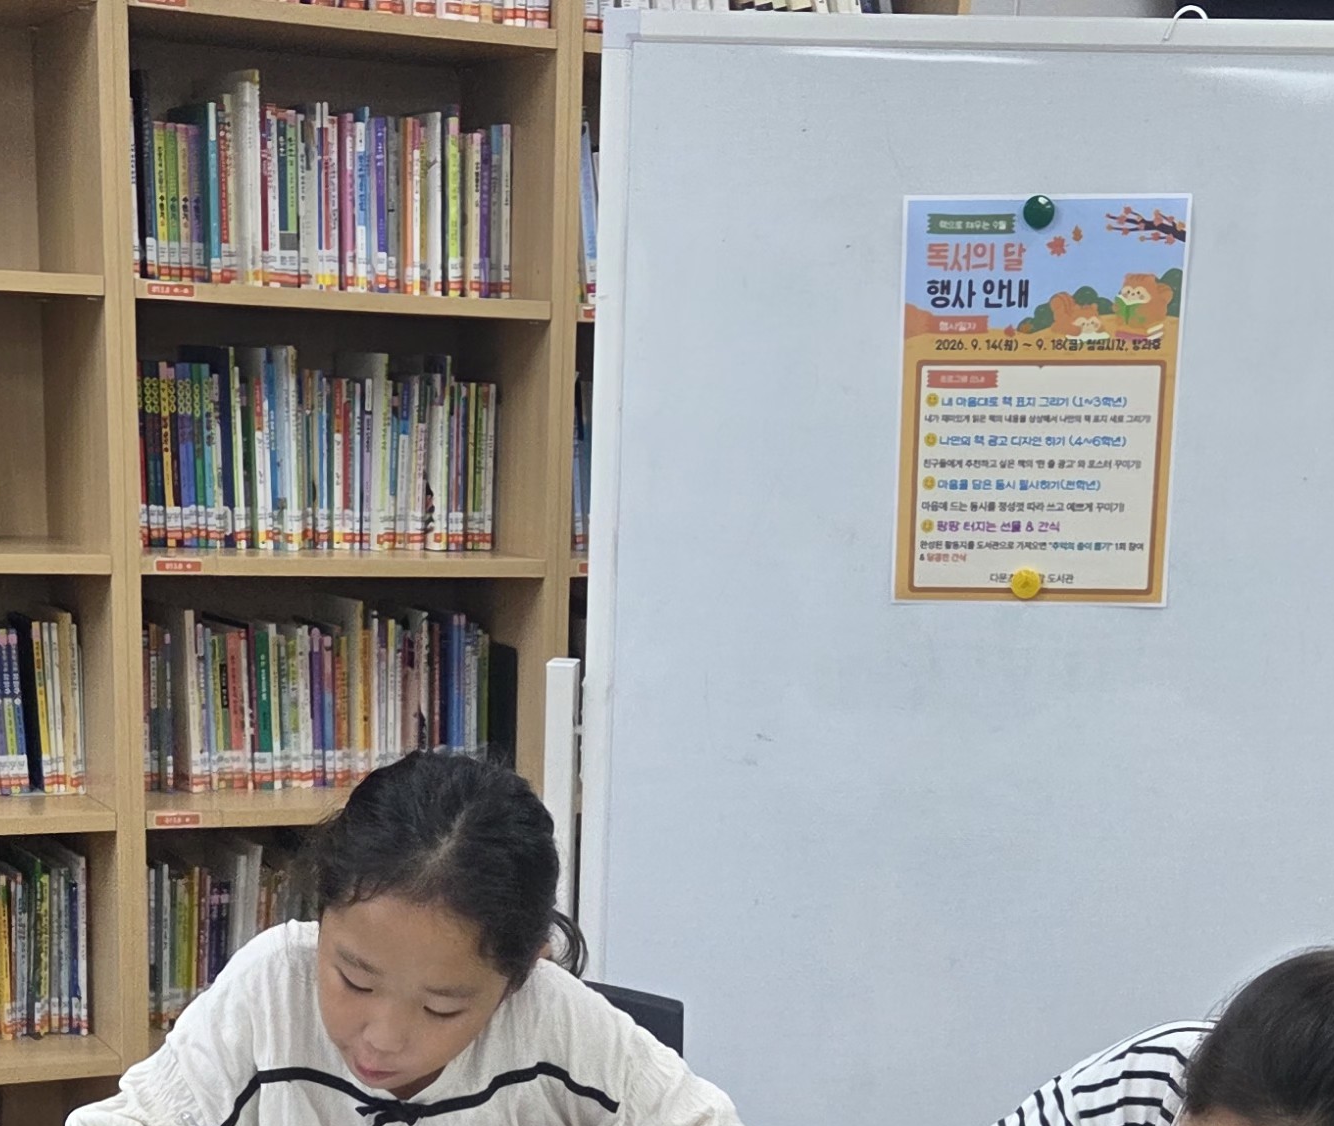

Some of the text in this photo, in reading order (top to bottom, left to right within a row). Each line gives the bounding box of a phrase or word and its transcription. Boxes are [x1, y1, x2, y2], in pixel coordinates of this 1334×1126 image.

[927, 242, 1026, 272] 독서의 달
[927, 279, 1029, 308] 행사 안내
[935, 339, 968, 351] 2026.
[971, 339, 982, 351] 9.
[985, 339, 1019, 352] 14(월)
[1036, 339, 1047, 351] 9.
[1051, 339, 1084, 352] 18(금)
[956, 397, 999, 407] 마음대로
[1016, 397, 1036, 407] 표지
[1038, 396, 1069, 407] 그리기
[1072, 395, 1128, 408] (1~3학년)
[939, 435, 971, 446] 나만의
[988, 435, 1008, 446] 광고
[1010, 436, 1043, 447] 디자인
[1045, 436, 1066, 446] 하기
[1069, 435, 1127, 447] (4~6학년)
[937, 479, 968, 490] 마음을
[995, 479, 1016, 490] 동시
[921, 501, 948, 512] 마음에
[950, 502, 968, 512] 드는
[970, 502, 996, 512] 동시를
[937, 520, 961, 532] 팡팡
[963, 520, 997, 532] 터지는
[1000, 521, 1021, 532] 선물
[1038, 521, 1060, 532] 간식
[976, 541, 1014, 550] 도서관으로
[1047, 573, 1074, 584] 도서관
